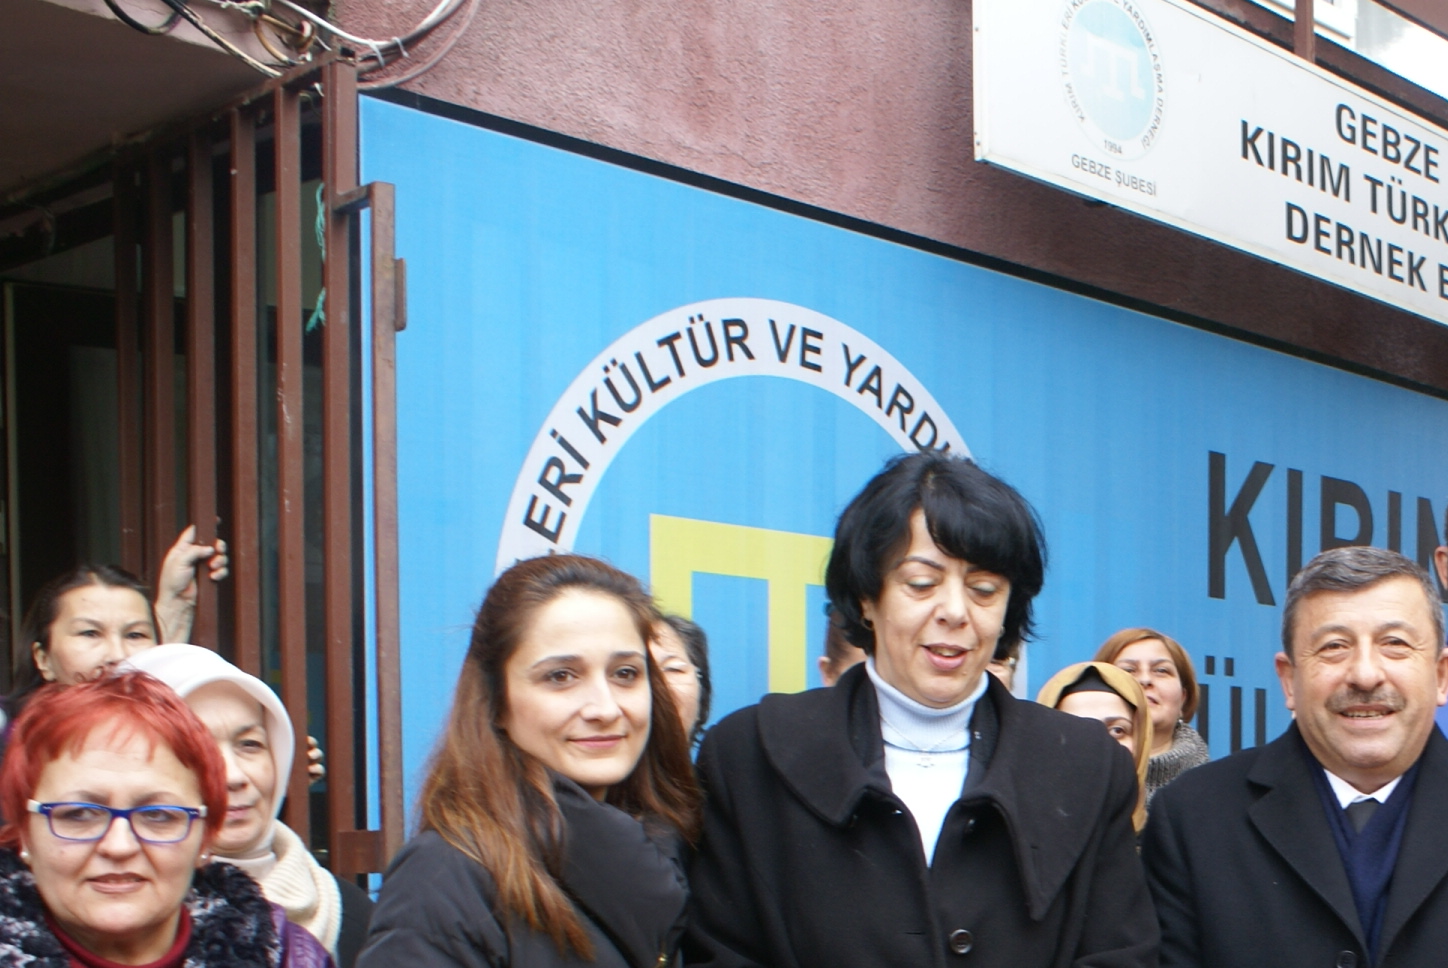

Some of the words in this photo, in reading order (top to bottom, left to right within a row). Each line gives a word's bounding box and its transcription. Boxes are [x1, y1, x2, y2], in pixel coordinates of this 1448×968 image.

[1071, 153, 1112, 181] GEBZE
[1114, 169, 1157, 197] ŞUBESİ
[1241, 119, 1351, 203] KIRIM
[1334, 103, 1440, 184] GEBZE
[1285, 200, 1427, 292] DERNEK
[518, 427, 591, 558] ERİ
[576, 313, 755, 446] KÜLTÜR
[768, 319, 824, 373] VE
